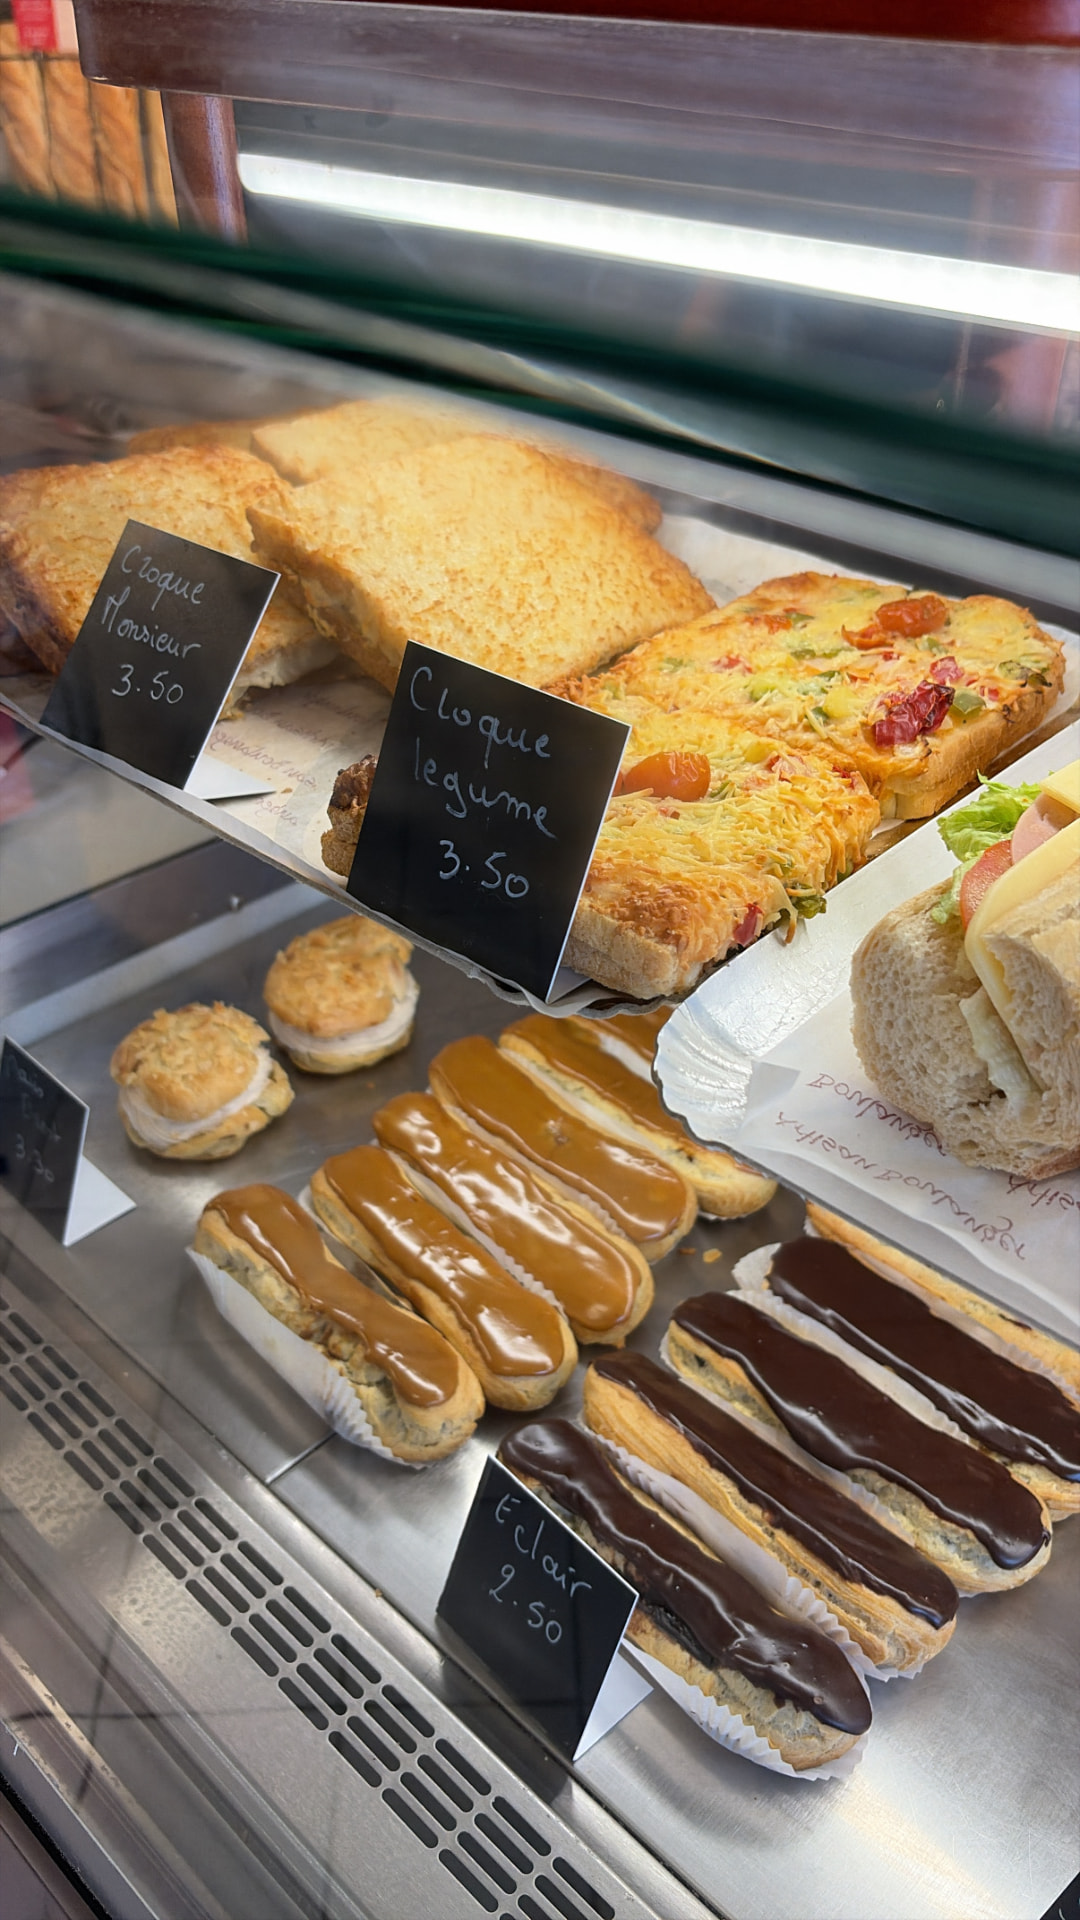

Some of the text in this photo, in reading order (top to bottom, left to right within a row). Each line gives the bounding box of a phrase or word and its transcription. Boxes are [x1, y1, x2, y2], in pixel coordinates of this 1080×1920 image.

[102, 586, 202, 659] Monsieur
[112, 664, 184, 704] 3.50
[439, 839, 530, 898] 3.50
[494, 1492, 593, 1598] Eclair
[488, 1563, 563, 1644] 2.50
